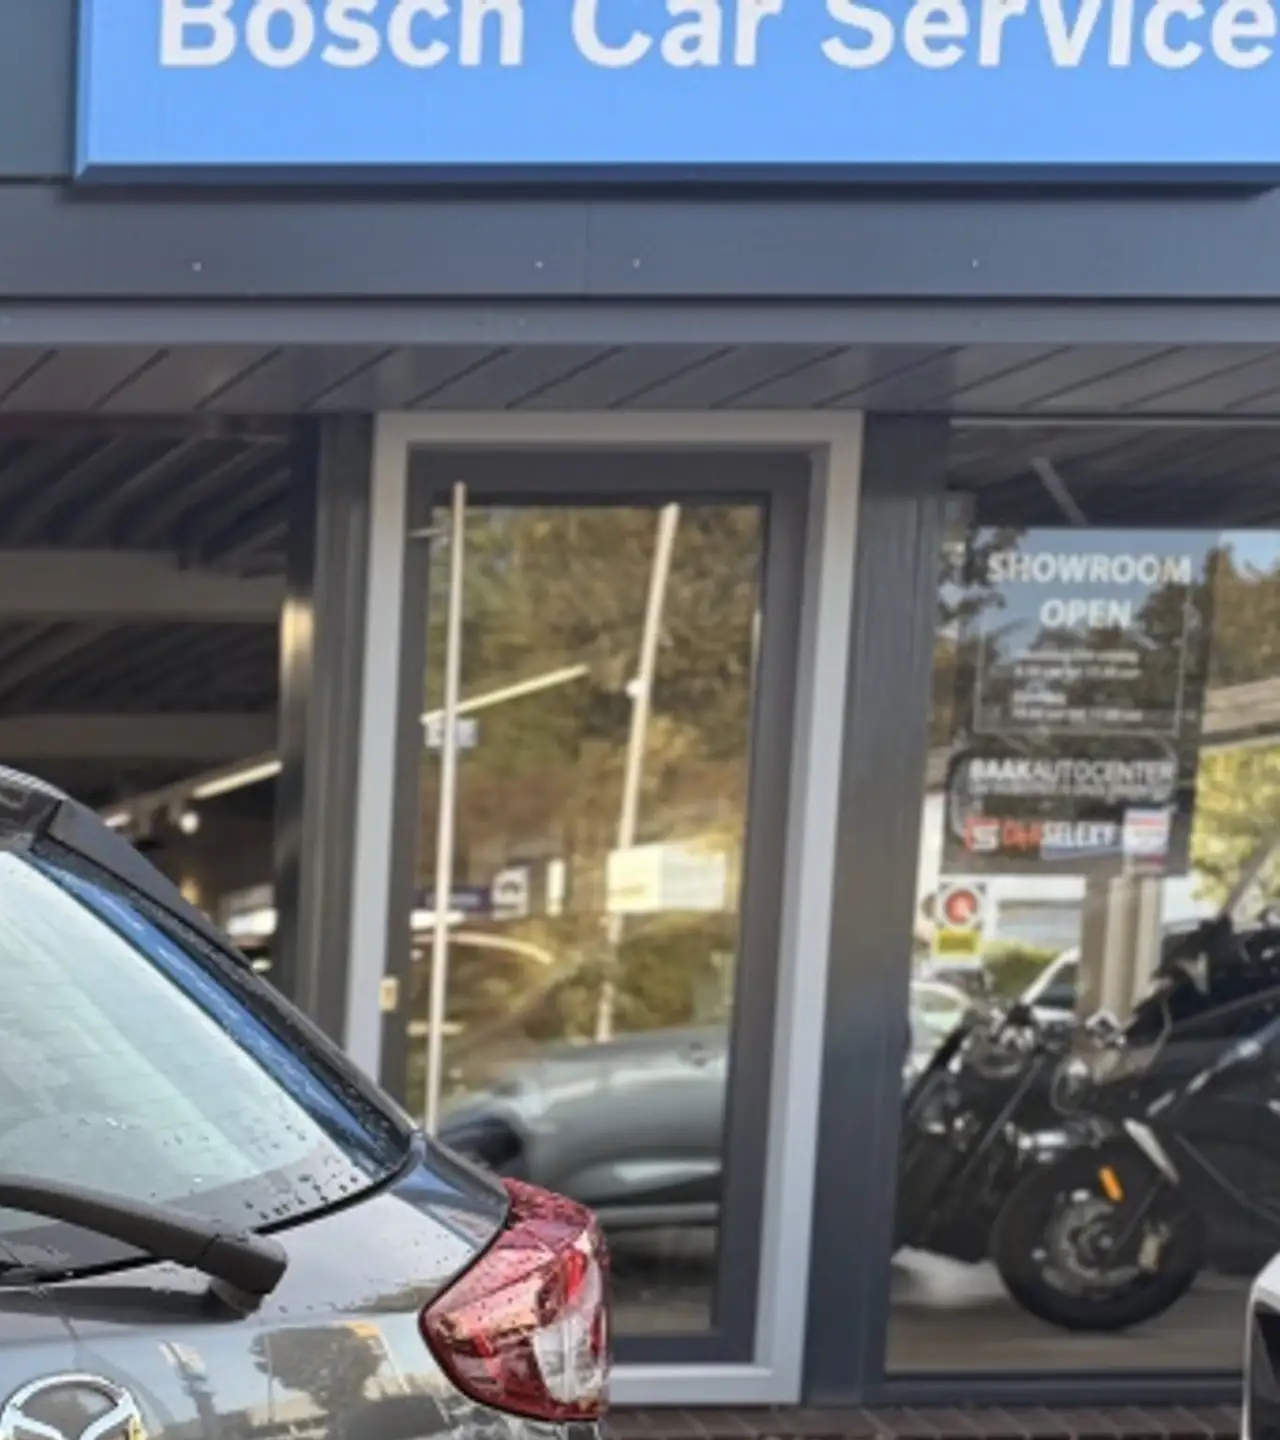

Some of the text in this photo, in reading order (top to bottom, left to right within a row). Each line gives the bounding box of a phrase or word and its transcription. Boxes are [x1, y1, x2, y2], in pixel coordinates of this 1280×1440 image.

[158, 0, 1278, 68] Bosch Car Service
[986, 552, 1192, 584] SHOWROOM
[1039, 600, 1132, 628] OPEN
